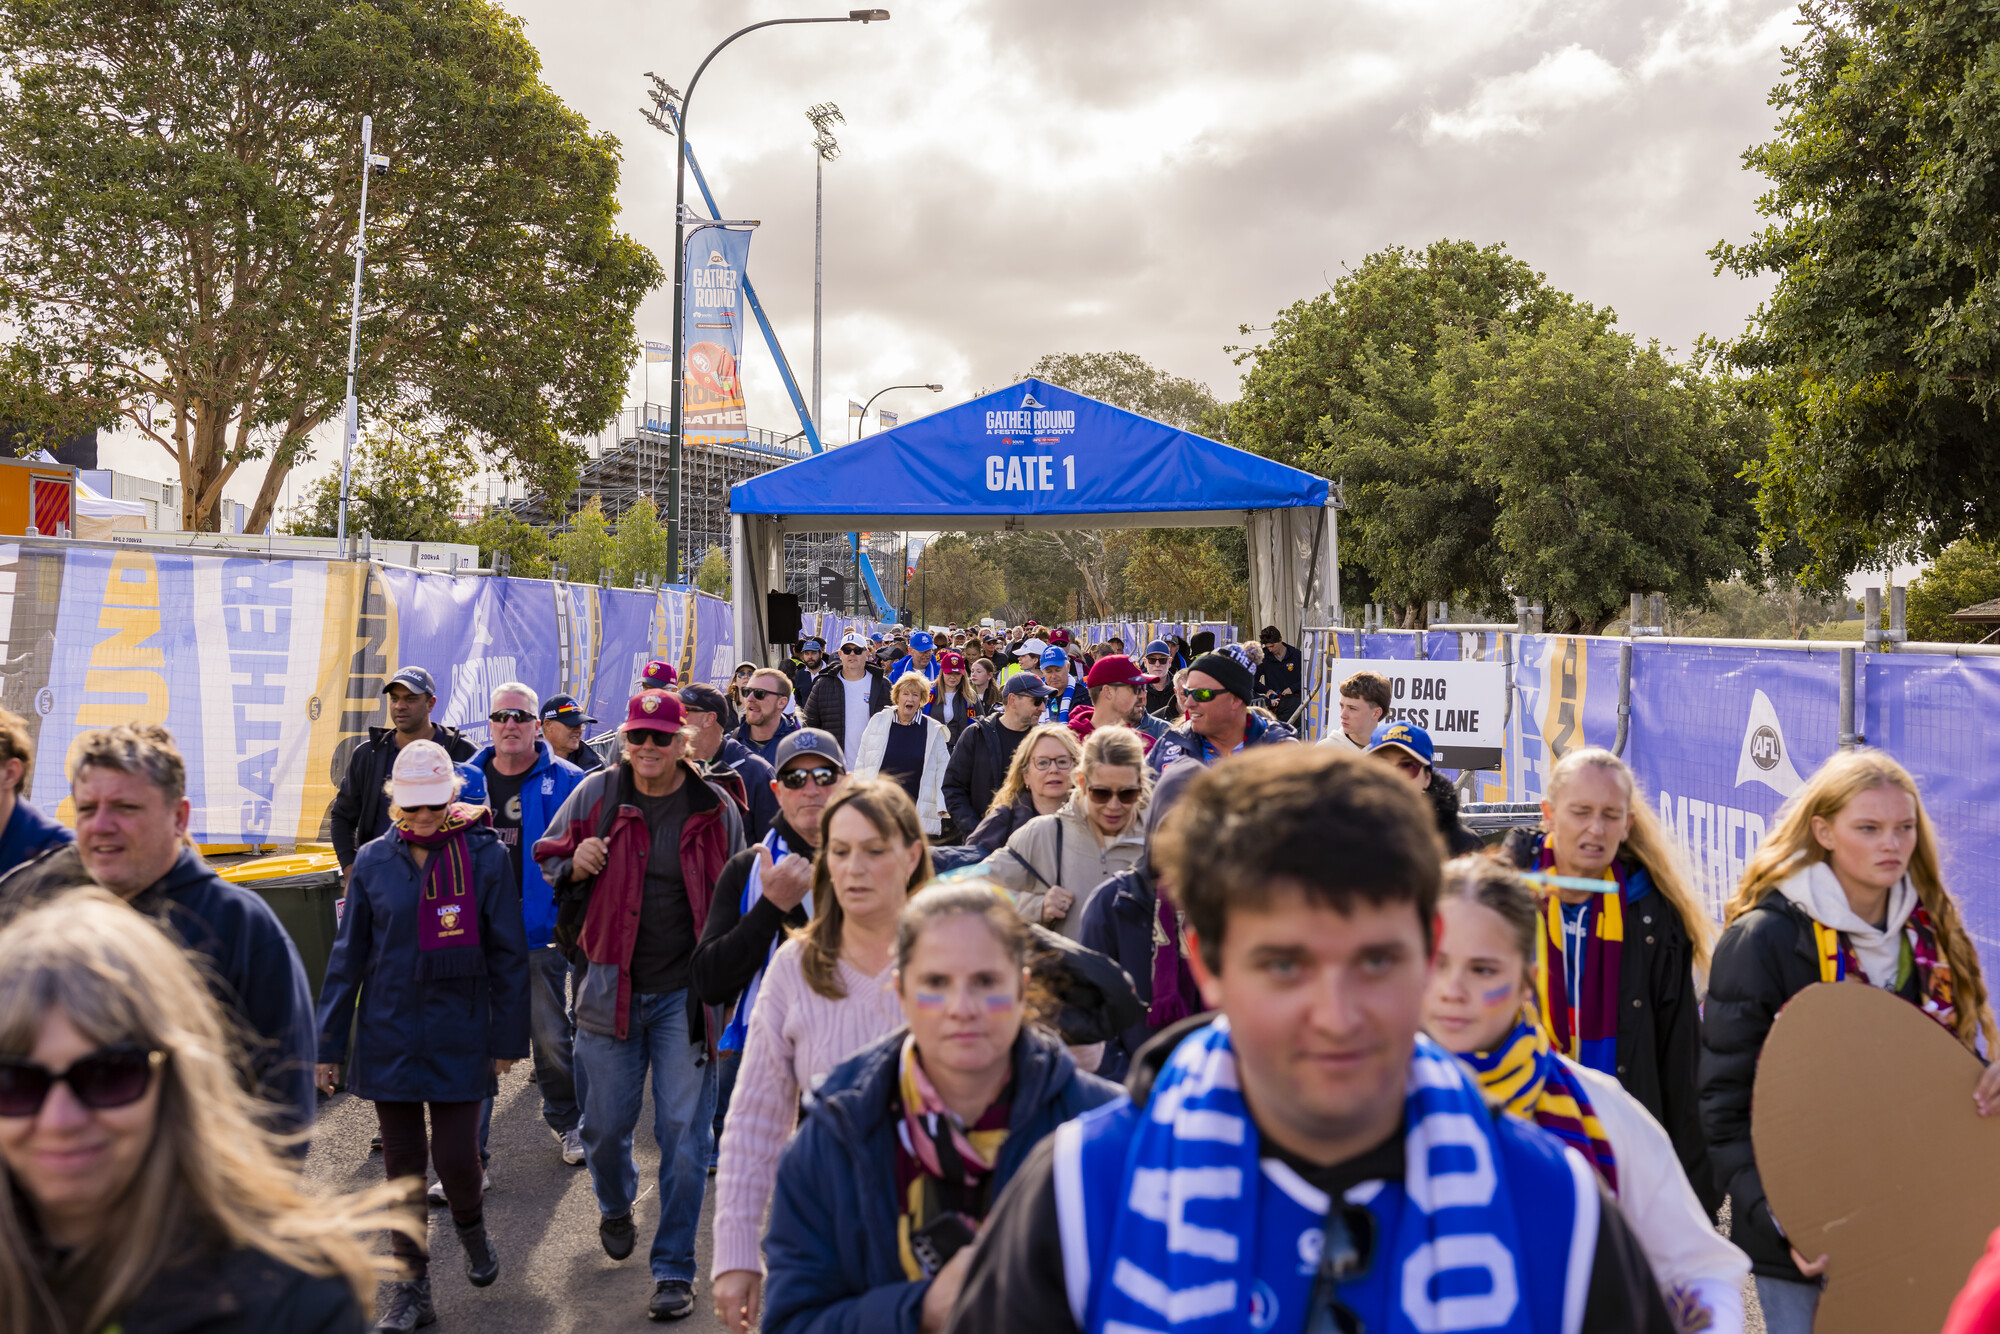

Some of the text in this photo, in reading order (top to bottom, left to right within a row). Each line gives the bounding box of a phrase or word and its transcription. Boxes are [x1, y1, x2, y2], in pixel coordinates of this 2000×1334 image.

[693, 268, 737, 289] GATHER
[695, 288, 736, 307] ROUND
[692, 353, 711, 373] AFL
[986, 410, 1075, 429] GATHER ROUND
[986, 455, 1075, 491] GATE 1
[1411, 678, 1447, 701] BAG
[40, 690, 50, 714] AFL
[221, 557, 293, 845] GATHER
[311, 697, 319, 719] AFL
[1435, 709, 1479, 732] LANE
[1752, 735, 1779, 760] AFL
[437, 905, 461, 916] LIONS
